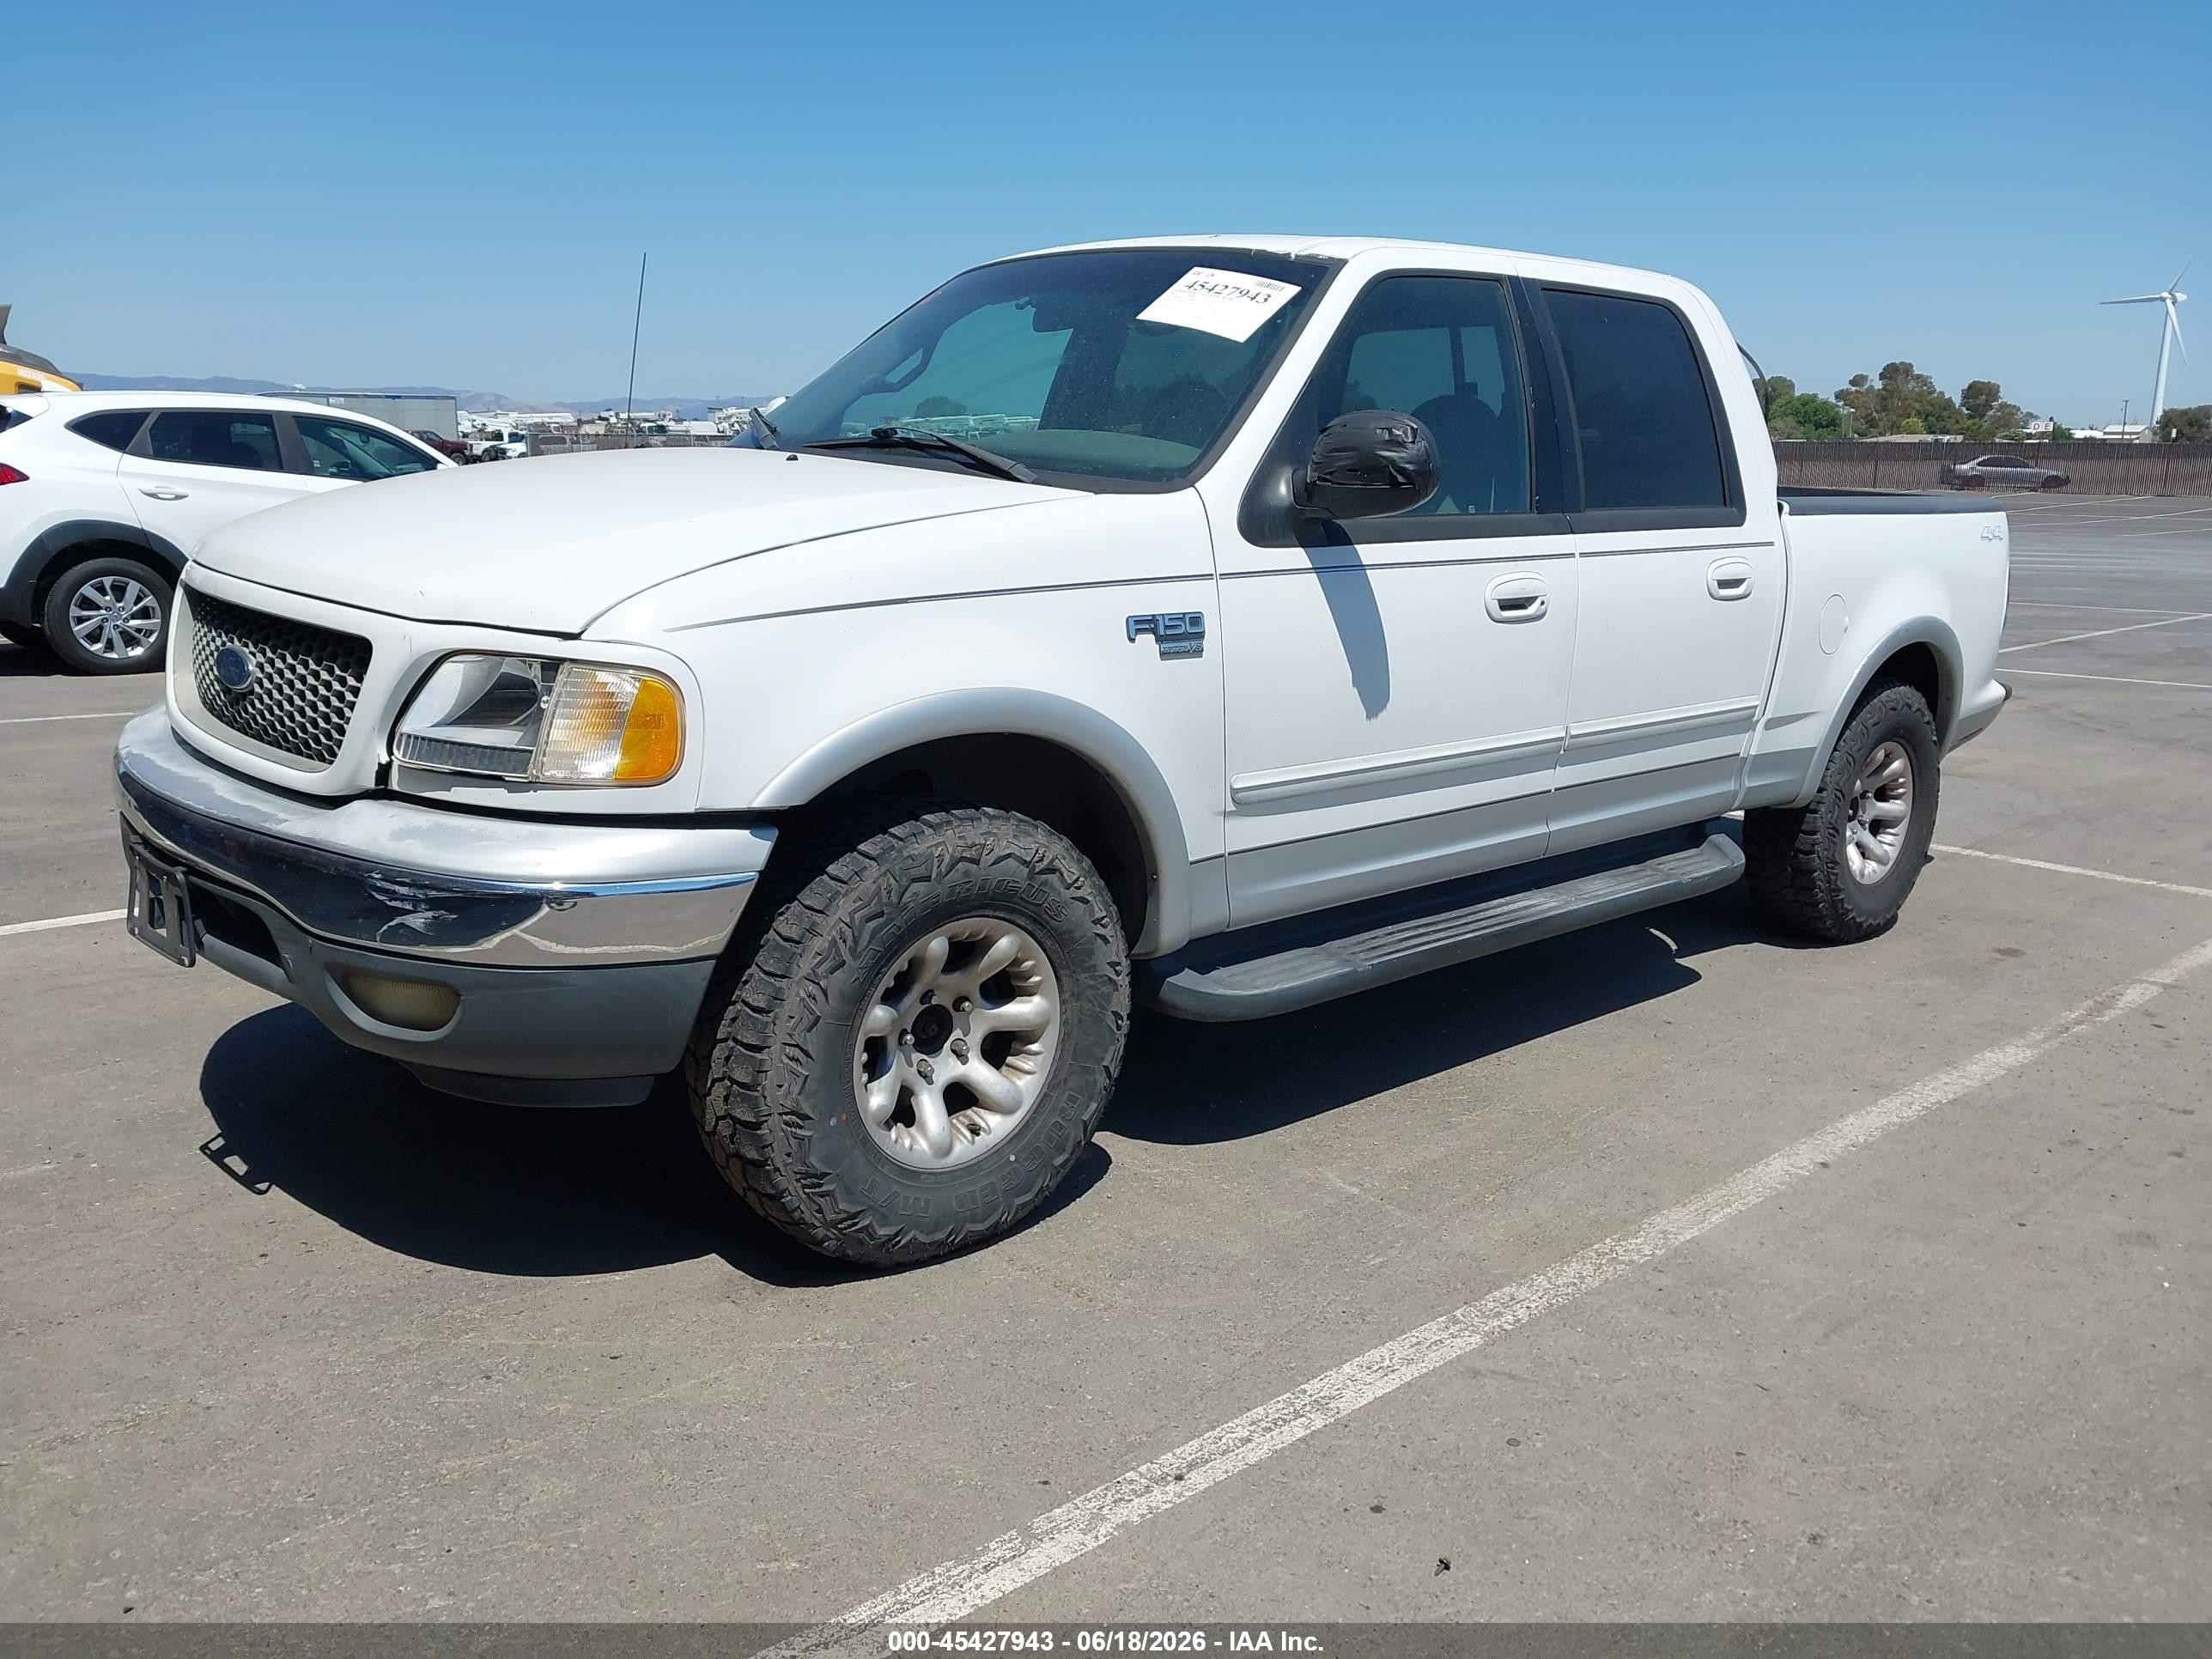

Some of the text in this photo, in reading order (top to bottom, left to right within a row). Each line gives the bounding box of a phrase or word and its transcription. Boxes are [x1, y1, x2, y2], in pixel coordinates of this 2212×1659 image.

[1184, 280, 1272, 304] 45427943
[1127, 612, 1205, 640] F-150
[952, 1091, 1085, 1213] RUGGED
[860, 1175, 933, 1218] M/T
